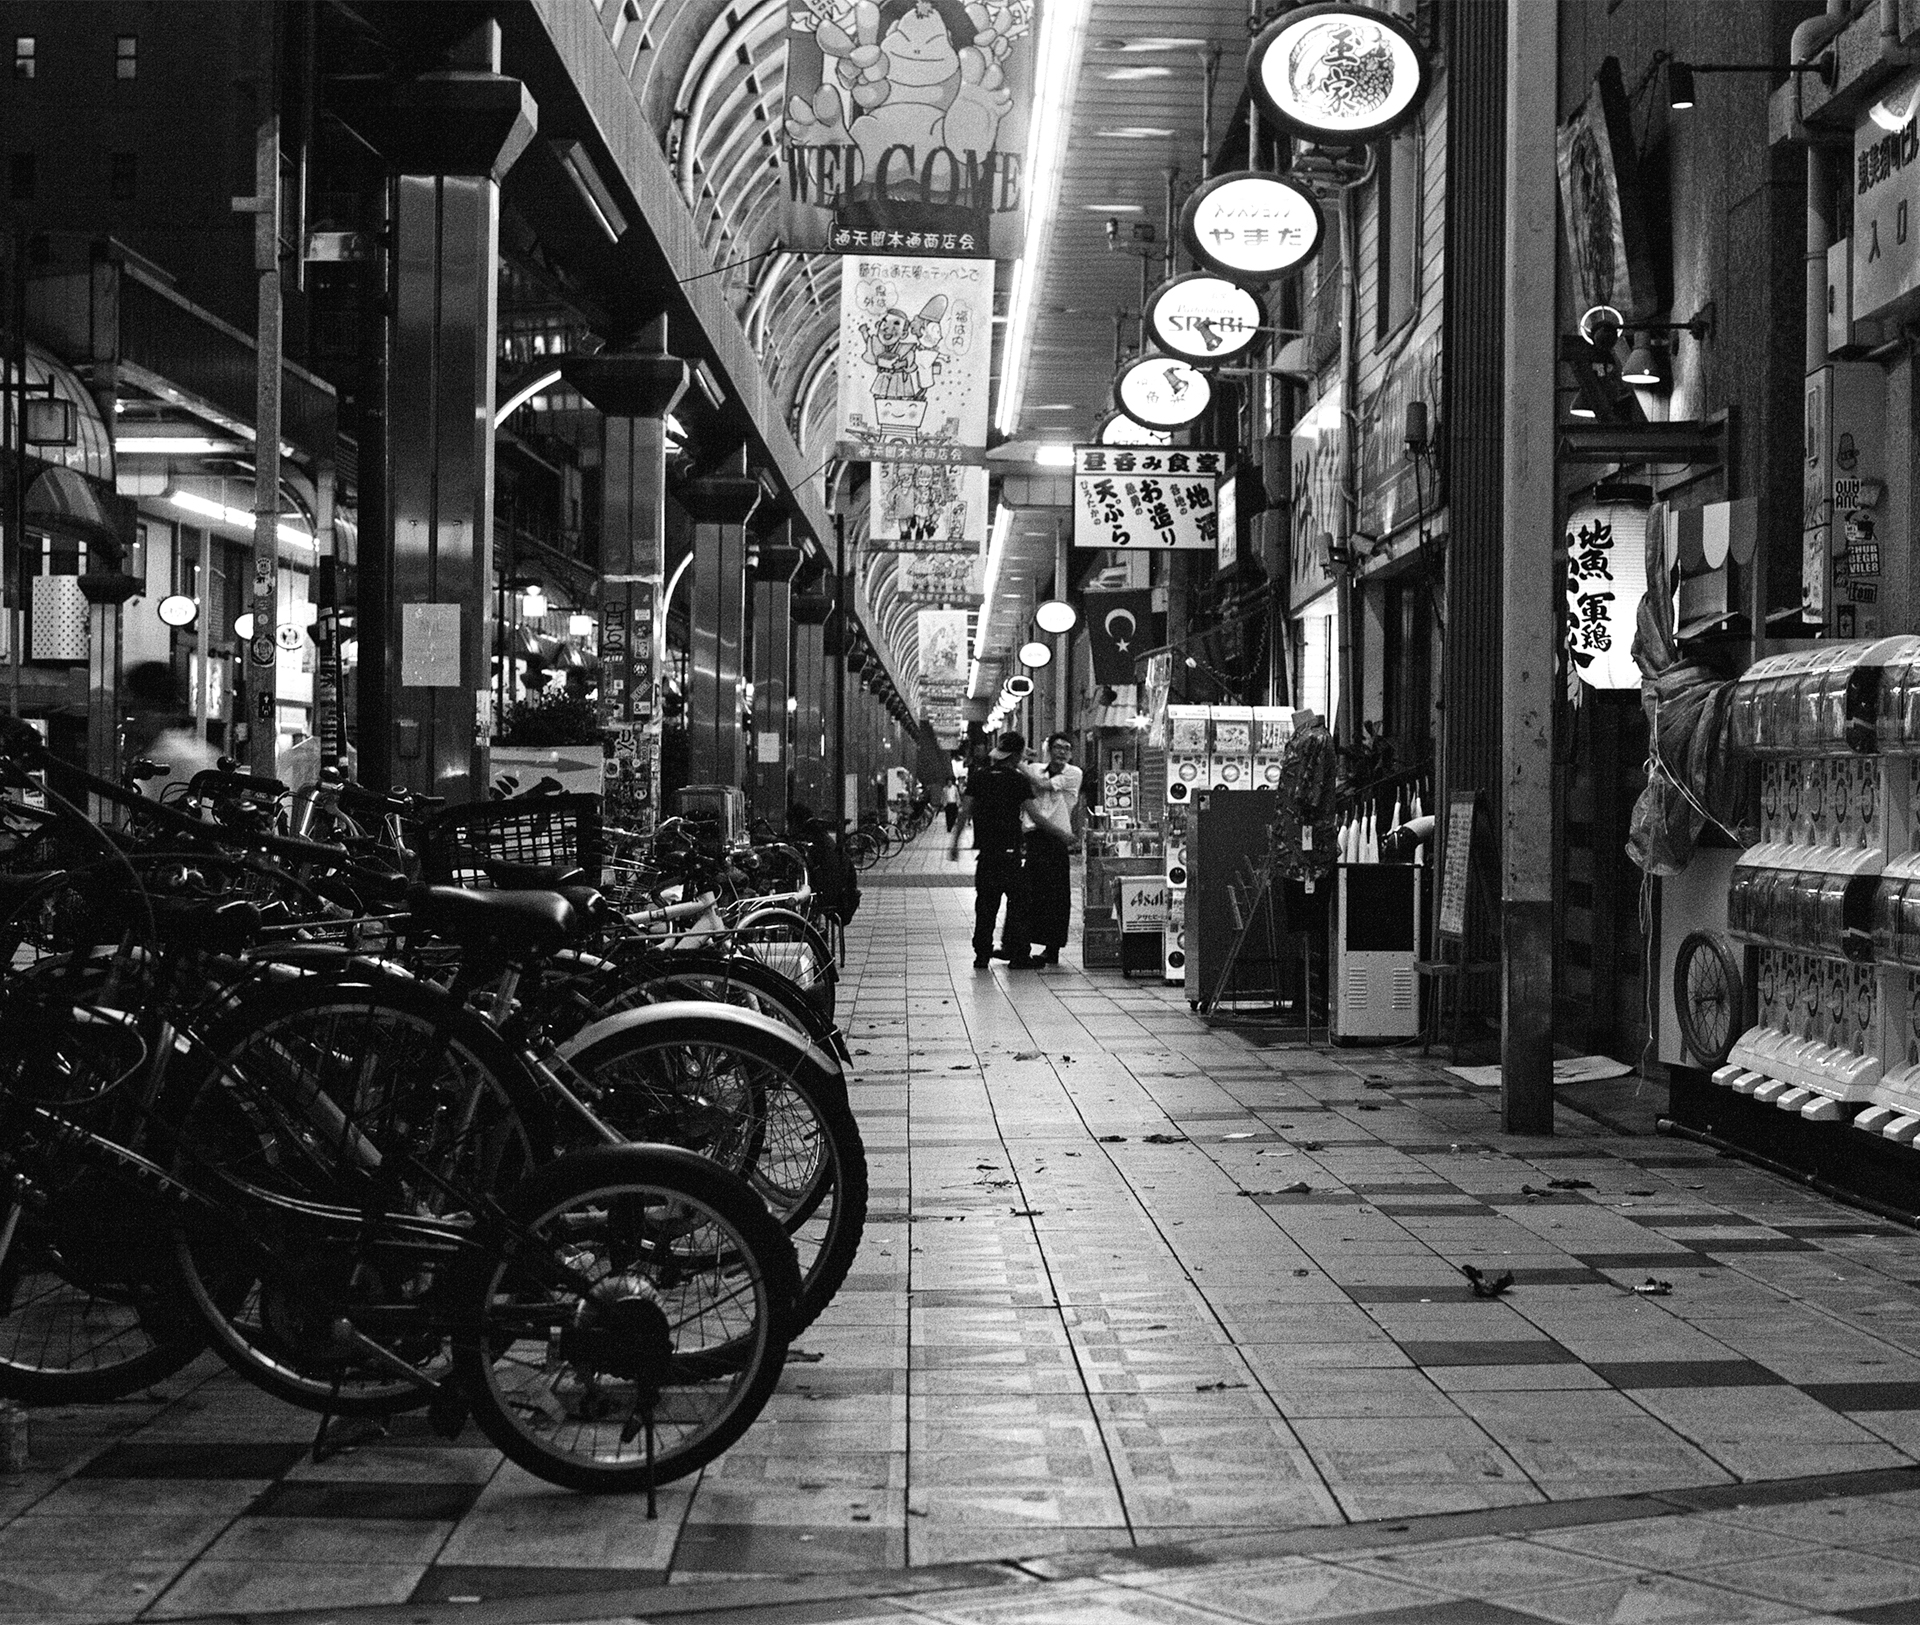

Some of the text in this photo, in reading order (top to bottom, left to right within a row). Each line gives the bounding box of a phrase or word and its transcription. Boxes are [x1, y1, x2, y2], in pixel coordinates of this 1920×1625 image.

[786, 144, 1021, 213] WELCOME
[835, 229, 974, 250] 通天閣本通商店会
[1209, 228, 1302, 247] やまだ
[1868, 199, 1908, 264] 入口
[1083, 452, 1220, 474] 昼呑み食堂
[1093, 478, 1131, 546] 天ぷら
[1140, 479, 1176, 547] お造り
[1186, 482, 1217, 542] 地酒
[1578, 518, 1615, 581] 地魚
[1576, 591, 1616, 653] 軍鶏
